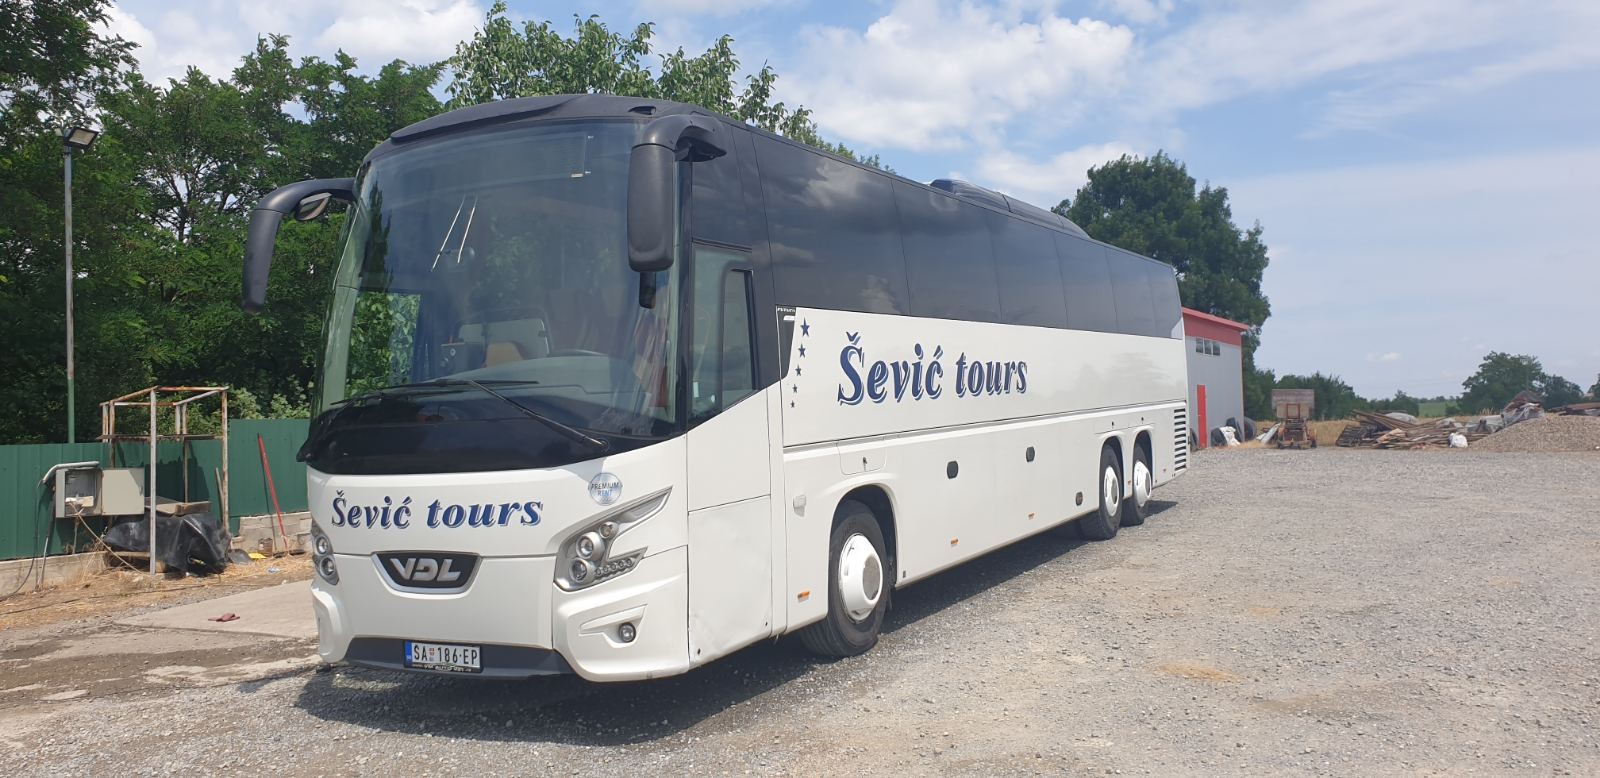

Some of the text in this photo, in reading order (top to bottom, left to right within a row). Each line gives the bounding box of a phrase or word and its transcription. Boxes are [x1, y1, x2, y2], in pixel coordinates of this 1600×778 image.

[837, 331, 1028, 406] Šević tours
[590, 482, 619, 490] PREMIUM
[597, 489, 612, 497] RENT
[331, 489, 544, 529] Šević tours
[389, 557, 462, 582] VDL
[413, 644, 428, 662] SA
